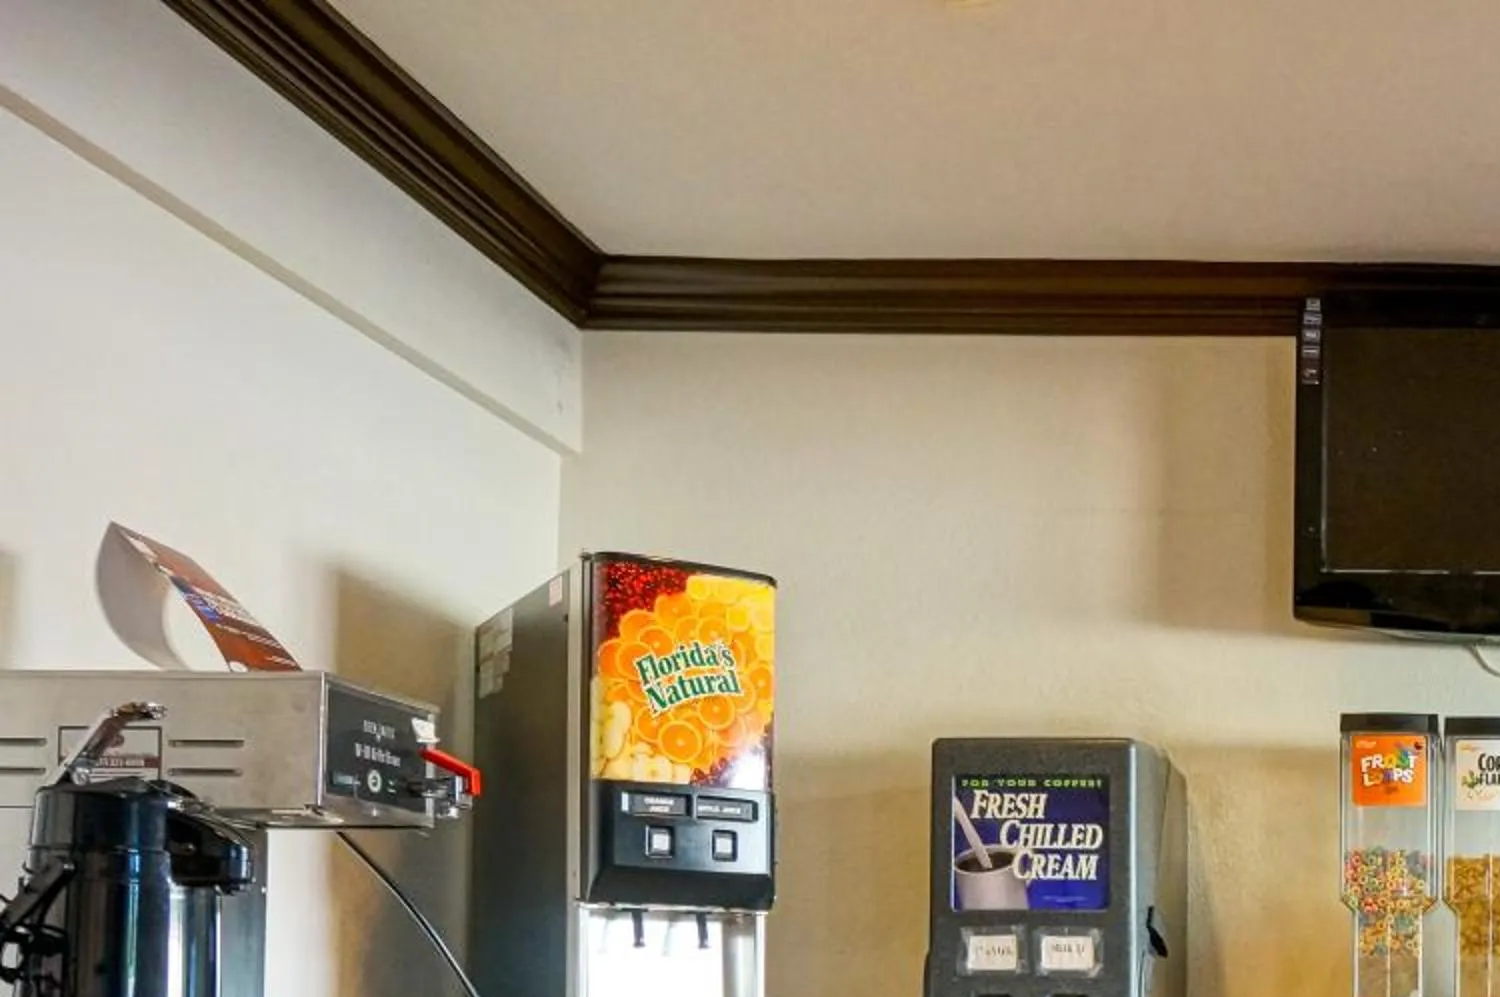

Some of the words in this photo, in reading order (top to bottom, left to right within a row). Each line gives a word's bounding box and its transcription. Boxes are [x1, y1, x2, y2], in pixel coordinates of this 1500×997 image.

[635, 639, 736, 684] Florida's
[645, 669, 742, 714] Natural
[998, 779, 1037, 788] YOUR
[970, 789, 1048, 819] FRESH
[1000, 819, 1104, 850] CHILLED
[1011, 850, 1099, 881] CREAM
